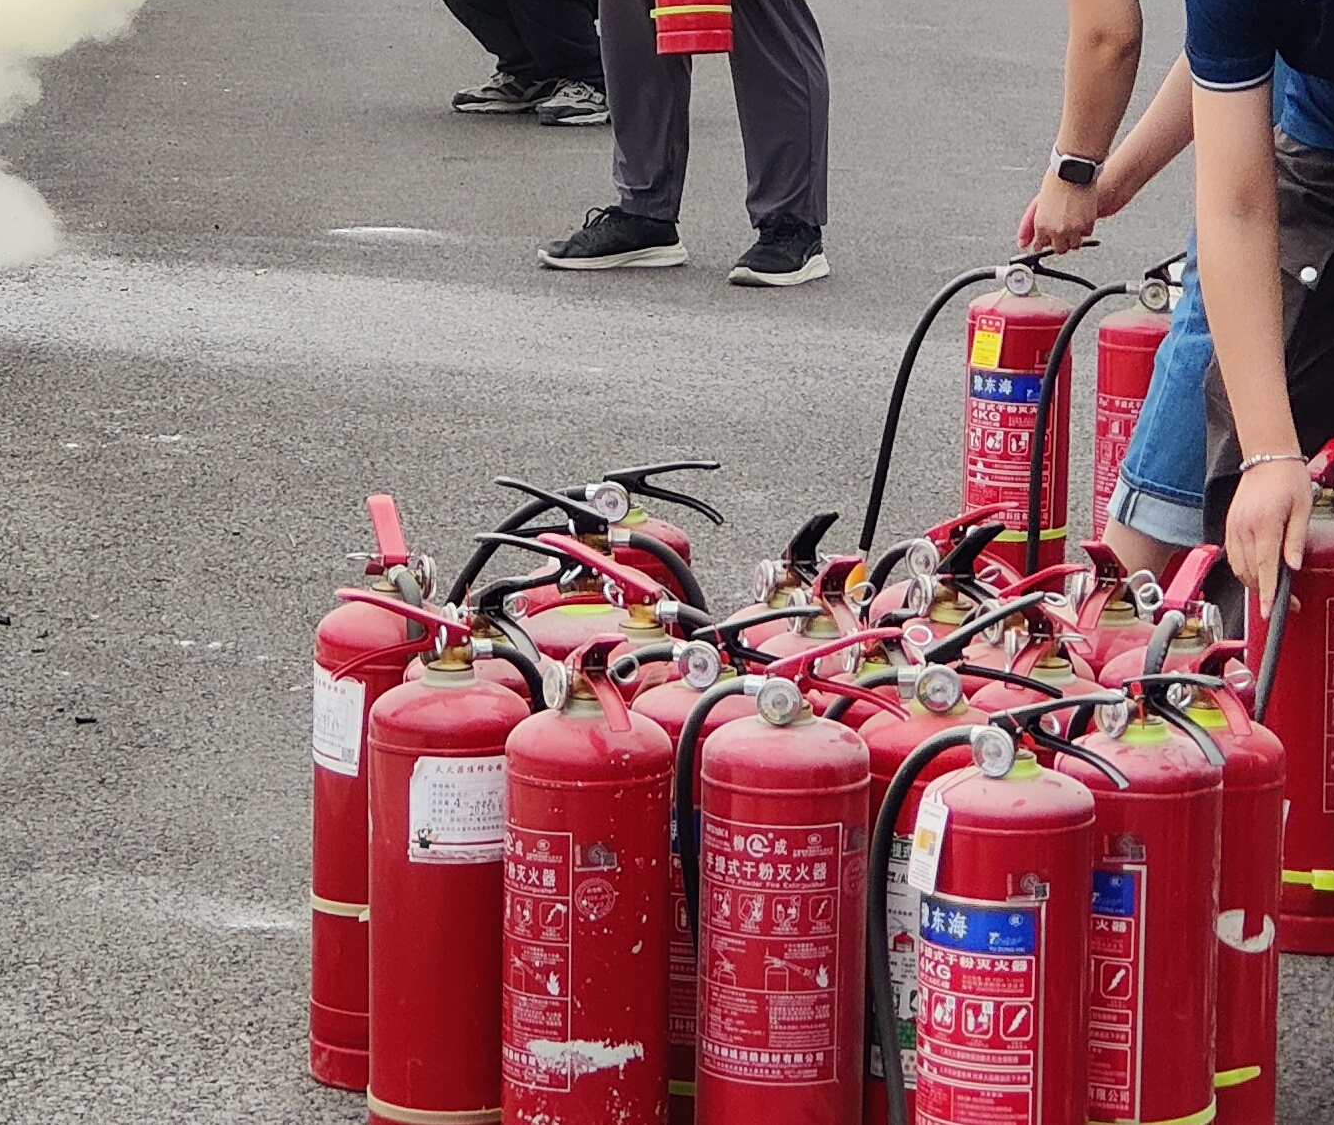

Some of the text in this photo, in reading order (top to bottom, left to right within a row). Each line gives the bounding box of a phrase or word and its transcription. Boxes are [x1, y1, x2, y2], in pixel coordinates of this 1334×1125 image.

[972, 409, 1001, 422] 4KG
[706, 851, 827, 881] 手提式干粉灭火器
